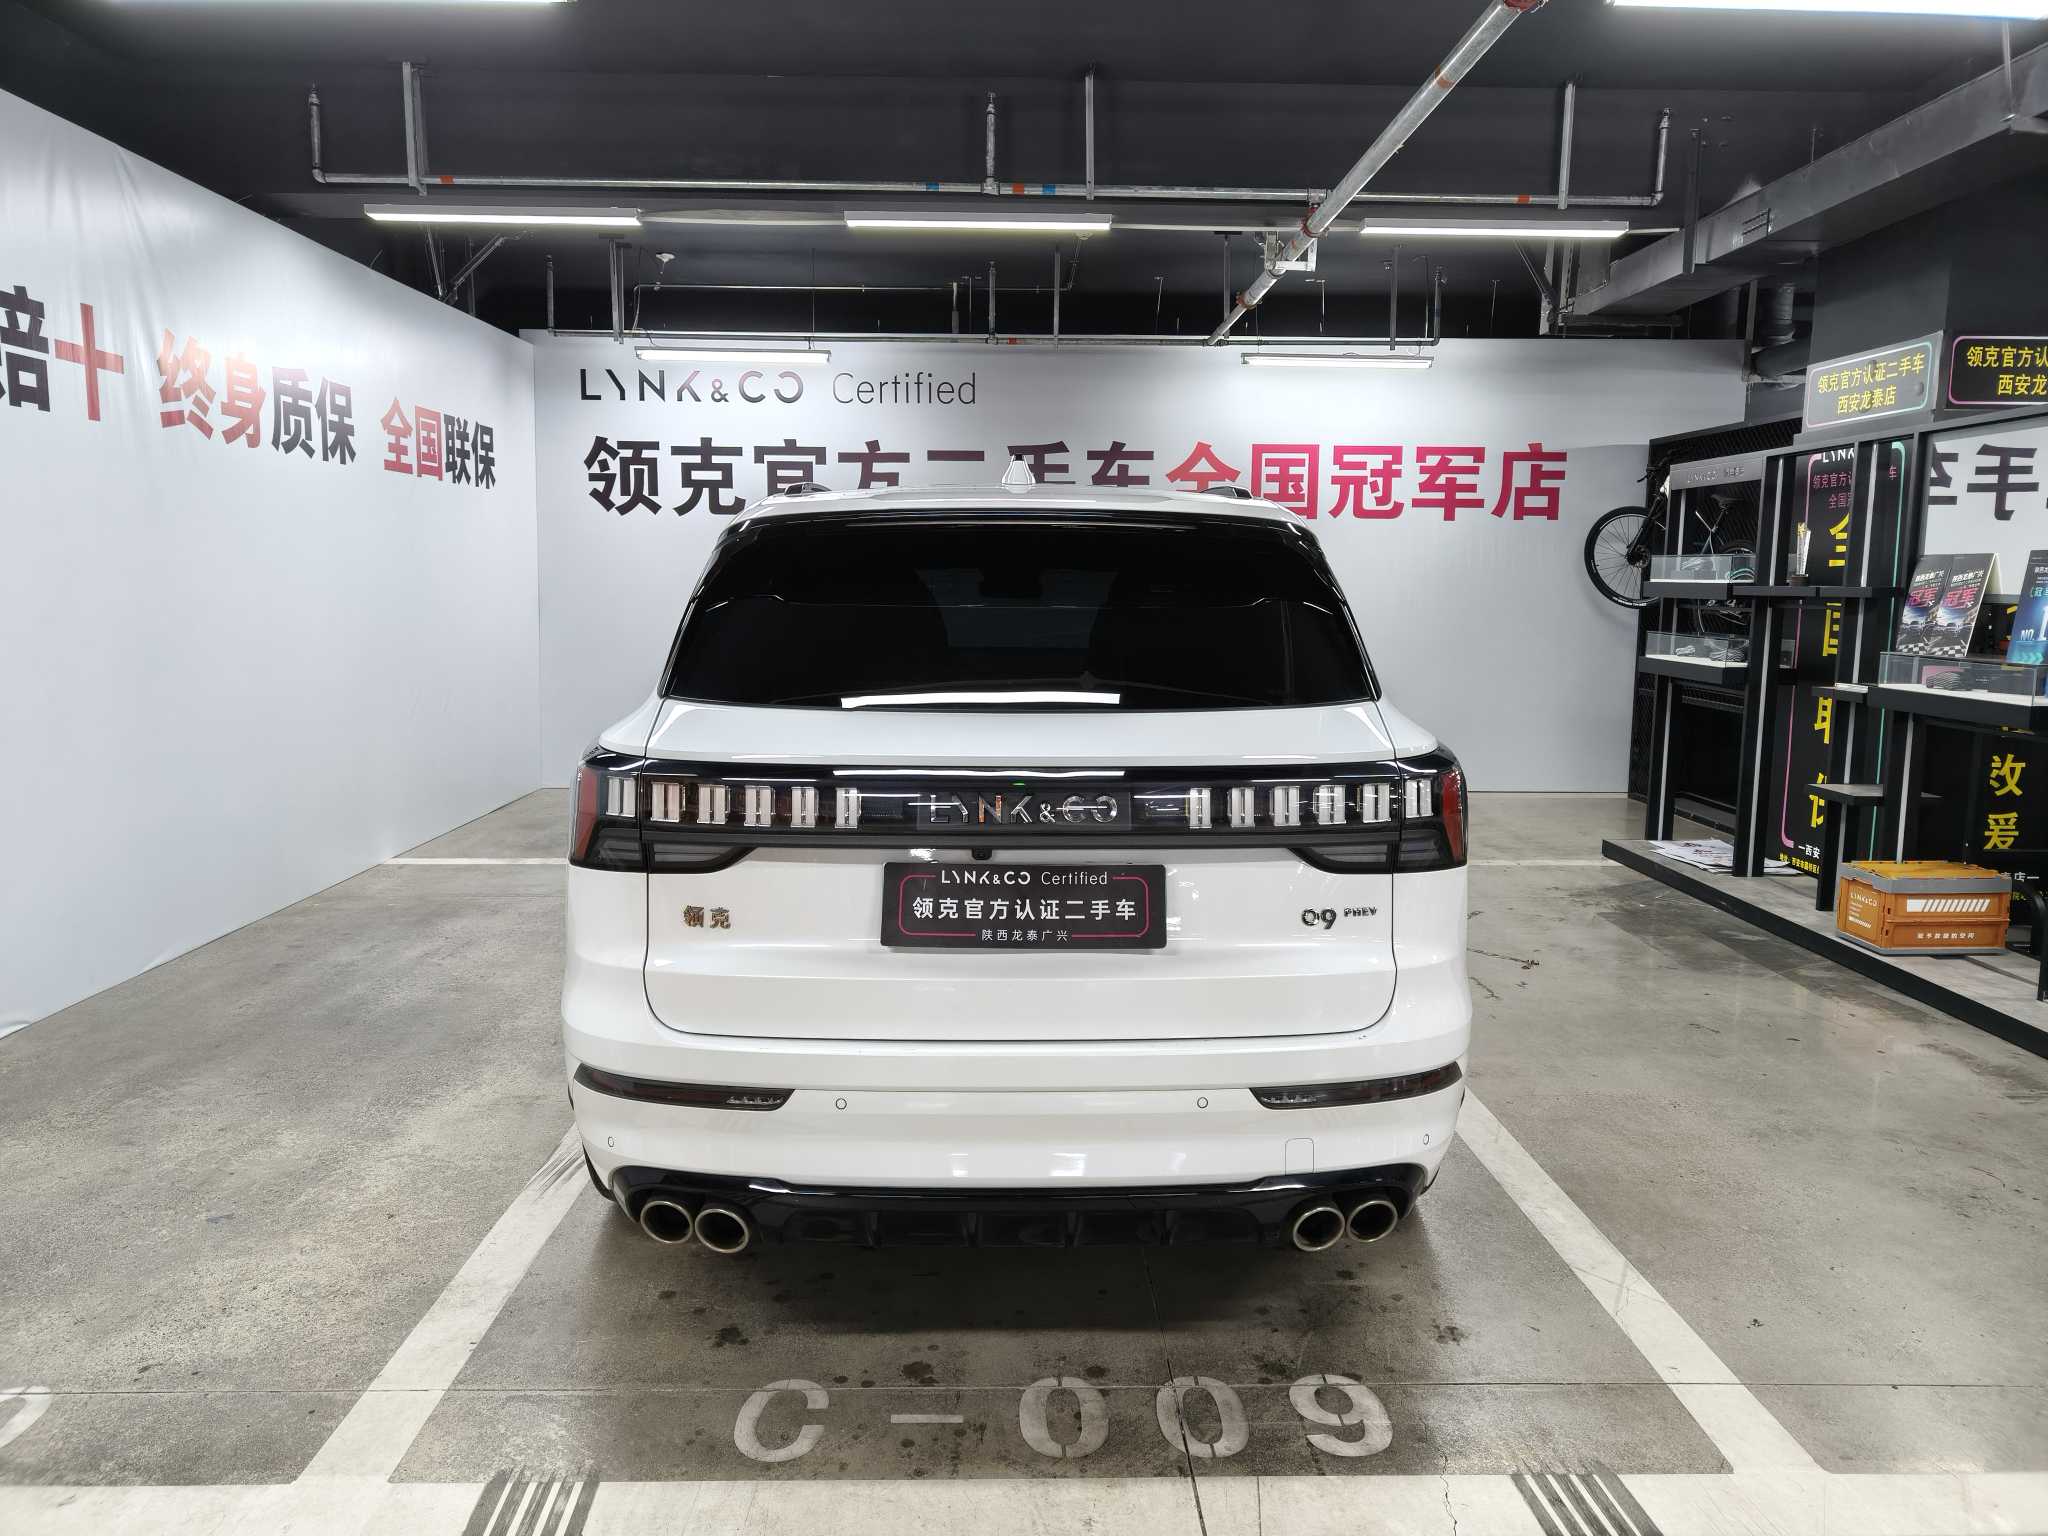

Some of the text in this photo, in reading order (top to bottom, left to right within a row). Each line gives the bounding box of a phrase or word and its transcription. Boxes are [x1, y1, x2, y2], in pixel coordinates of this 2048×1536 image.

[580, 368, 977, 404] LYNK&CO Certified
[1817, 352, 1925, 394] 领克官方认证二手车
[157, 328, 356, 465] 终身质保
[380, 396, 496, 489] 全国联保
[1837, 384, 1897, 415] 西安龙泰店
[930, 795, 1118, 823] LYNK&CO
[941, 870, 1108, 885] LYNK&CO Certified
[912, 896, 1136, 920] 领克官方认证二手车
[1343, 906, 1377, 917] PHEV
[981, 929, 1068, 941] 陕西龙泰广兴
